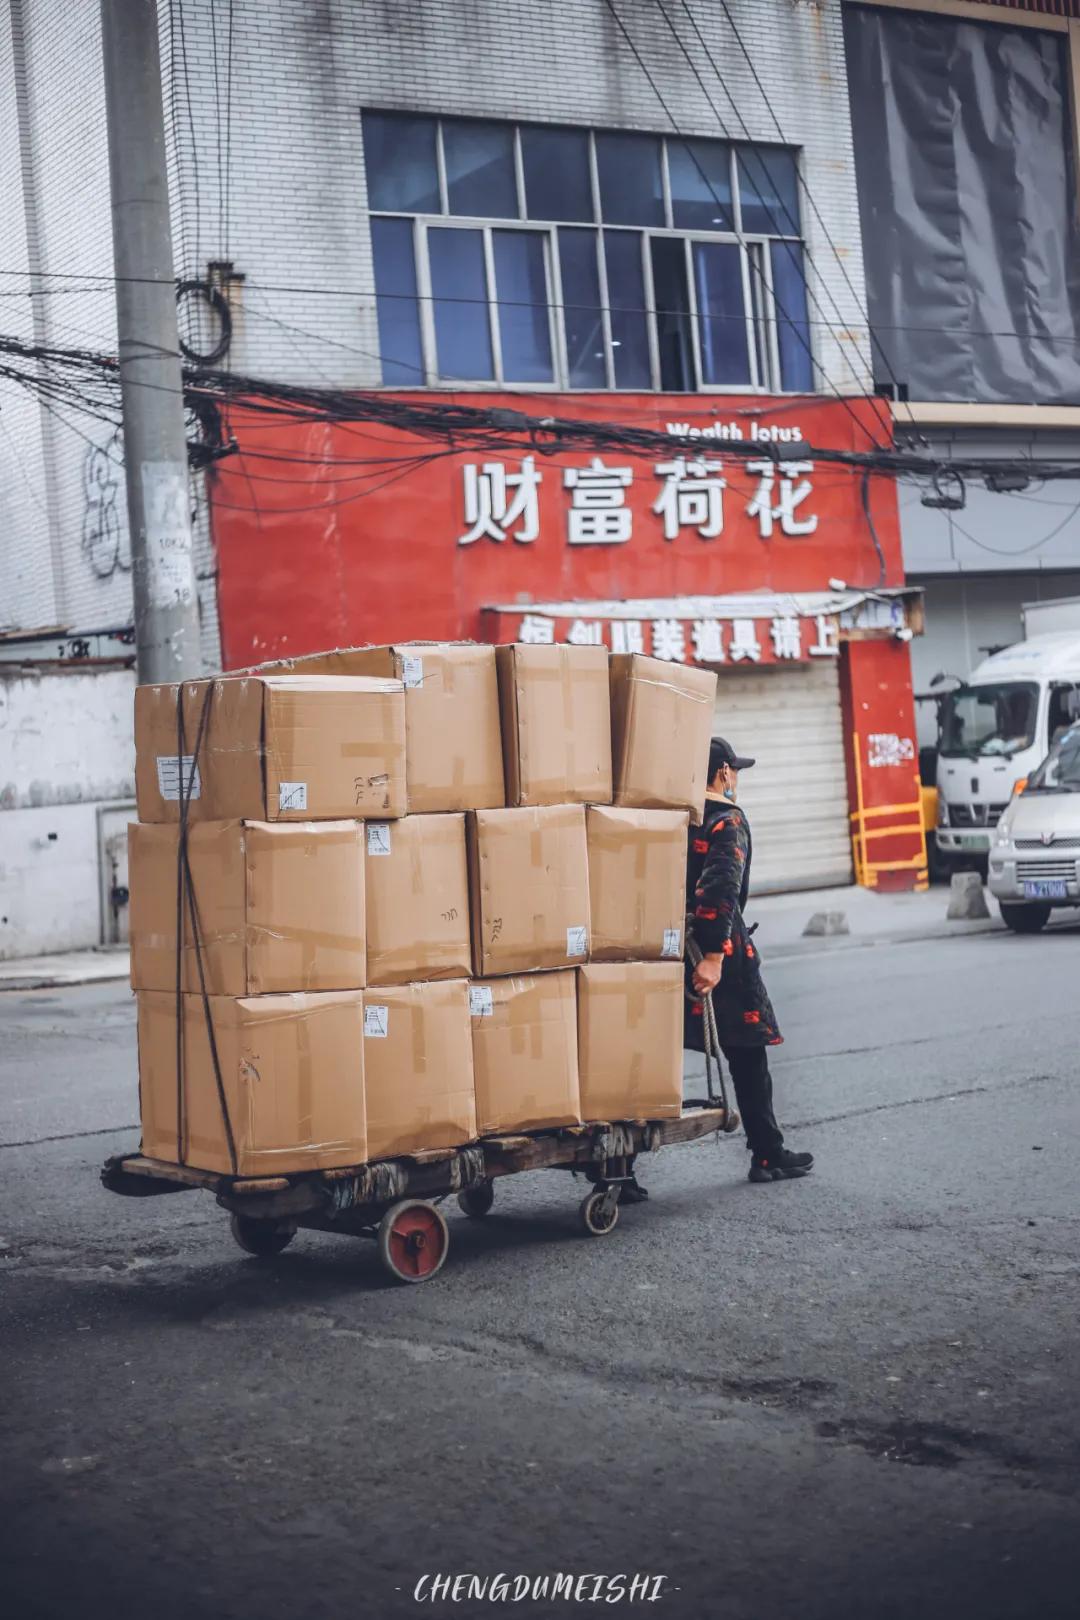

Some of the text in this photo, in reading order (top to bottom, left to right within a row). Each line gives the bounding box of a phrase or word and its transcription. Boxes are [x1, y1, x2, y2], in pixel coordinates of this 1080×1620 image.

[665, 421, 803, 442] Wealth lotus
[457, 454, 819, 545] 财富荷花
